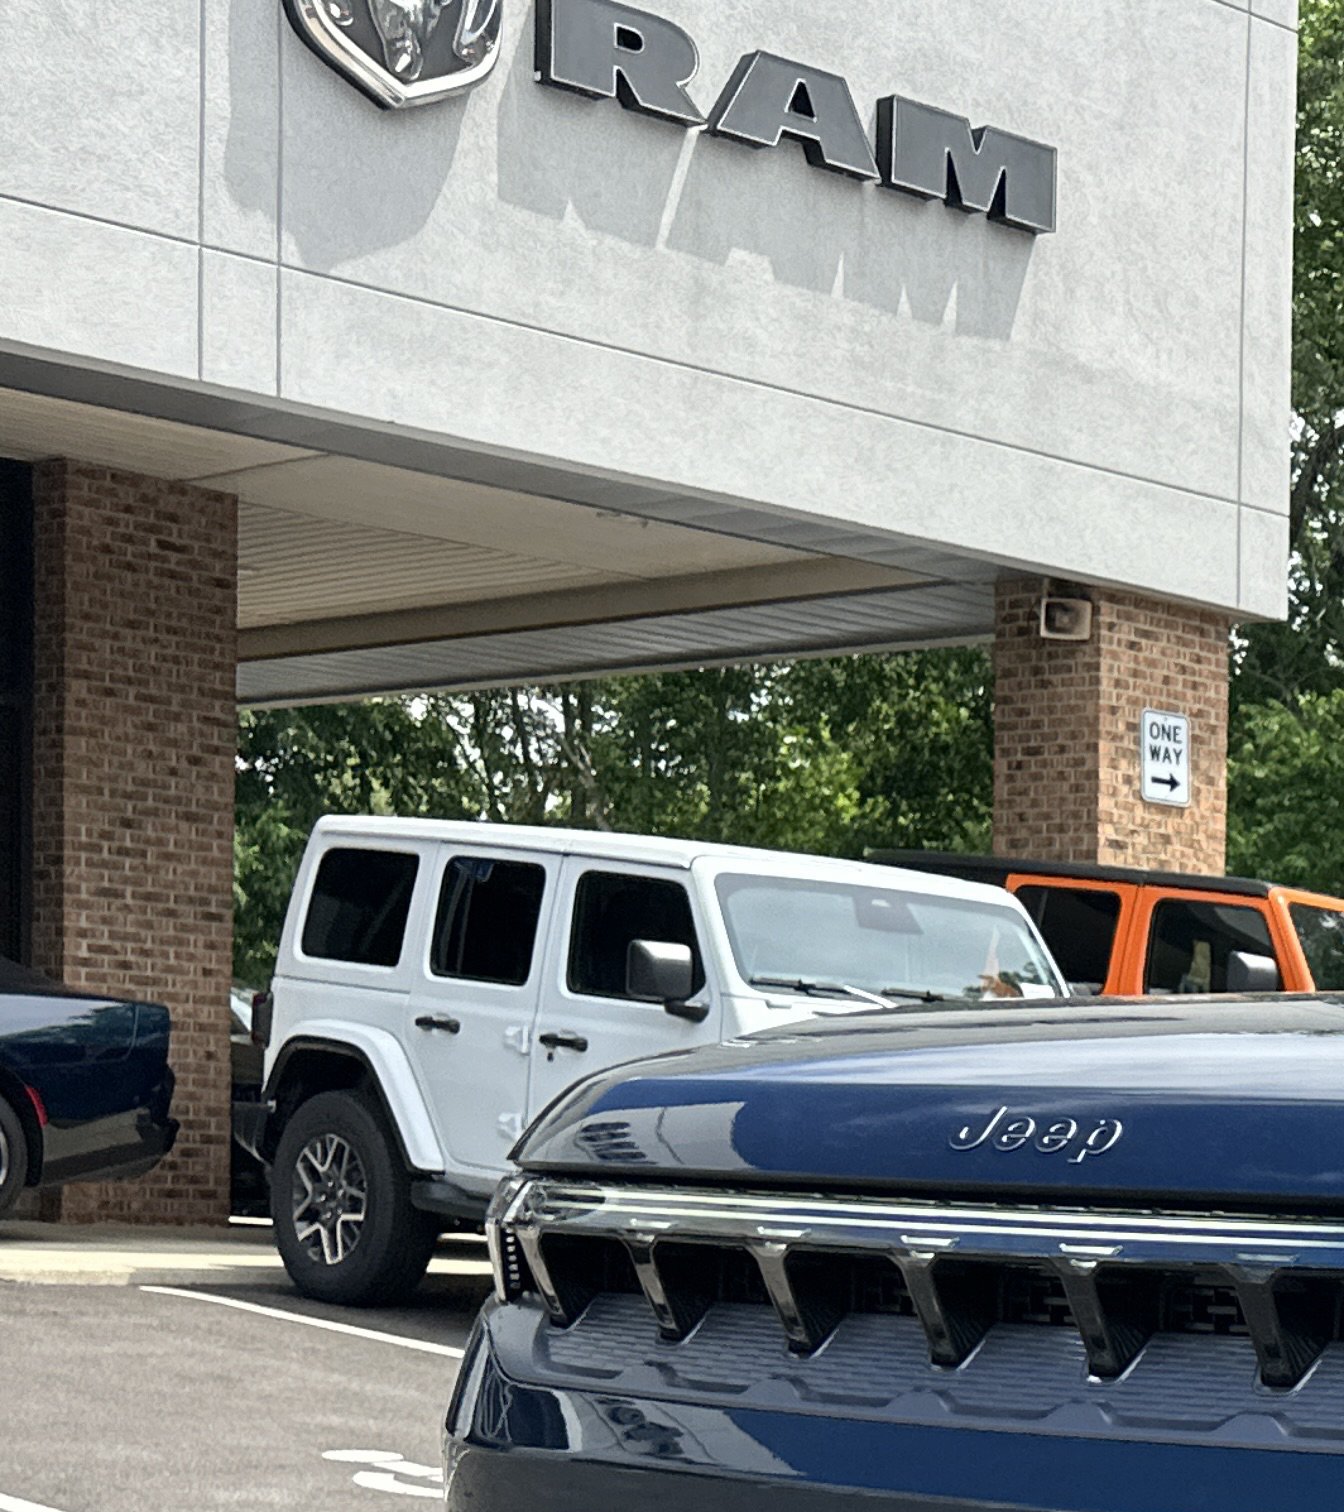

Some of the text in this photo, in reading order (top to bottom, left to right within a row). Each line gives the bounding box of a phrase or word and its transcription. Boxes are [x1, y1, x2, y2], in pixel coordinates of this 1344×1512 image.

[534, 0, 1057, 235] RAM
[1149, 721, 1183, 745] ONE
[1149, 743, 1183, 766] WAY
[948, 1105, 1124, 1164] Jeep
